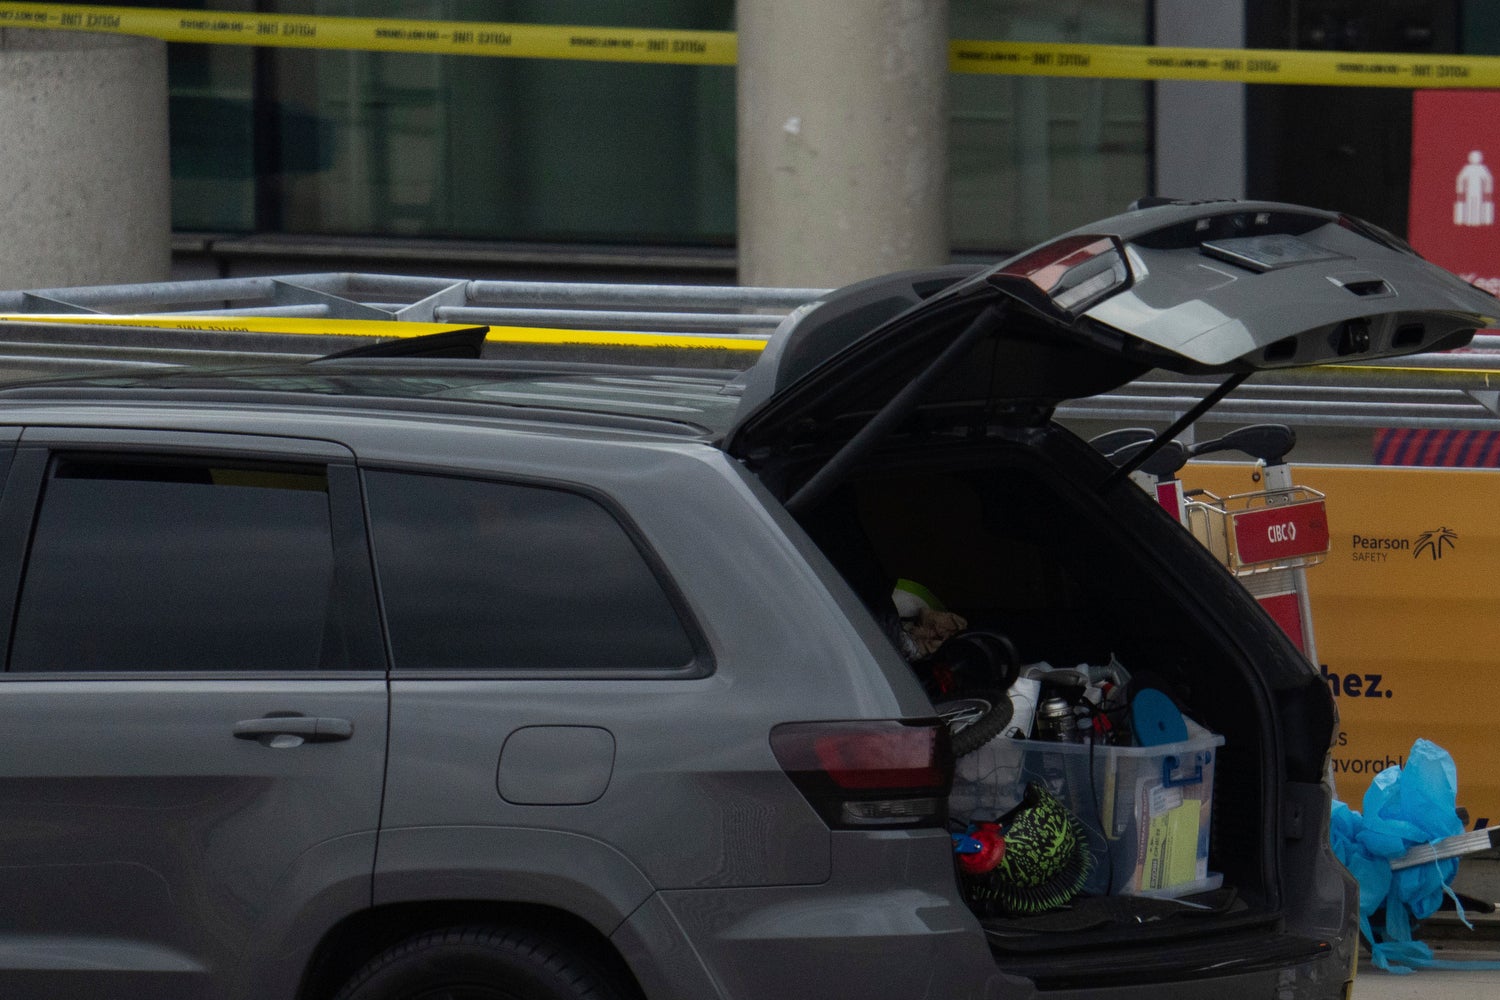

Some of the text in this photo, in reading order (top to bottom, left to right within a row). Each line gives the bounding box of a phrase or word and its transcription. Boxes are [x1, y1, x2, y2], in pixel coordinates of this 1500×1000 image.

[1268, 524, 1288, 543] CIBC
[1352, 534, 1409, 550] Pearson
[1352, 552, 1387, 562] SAFETY
[1332, 755, 1407, 773] avorabl
